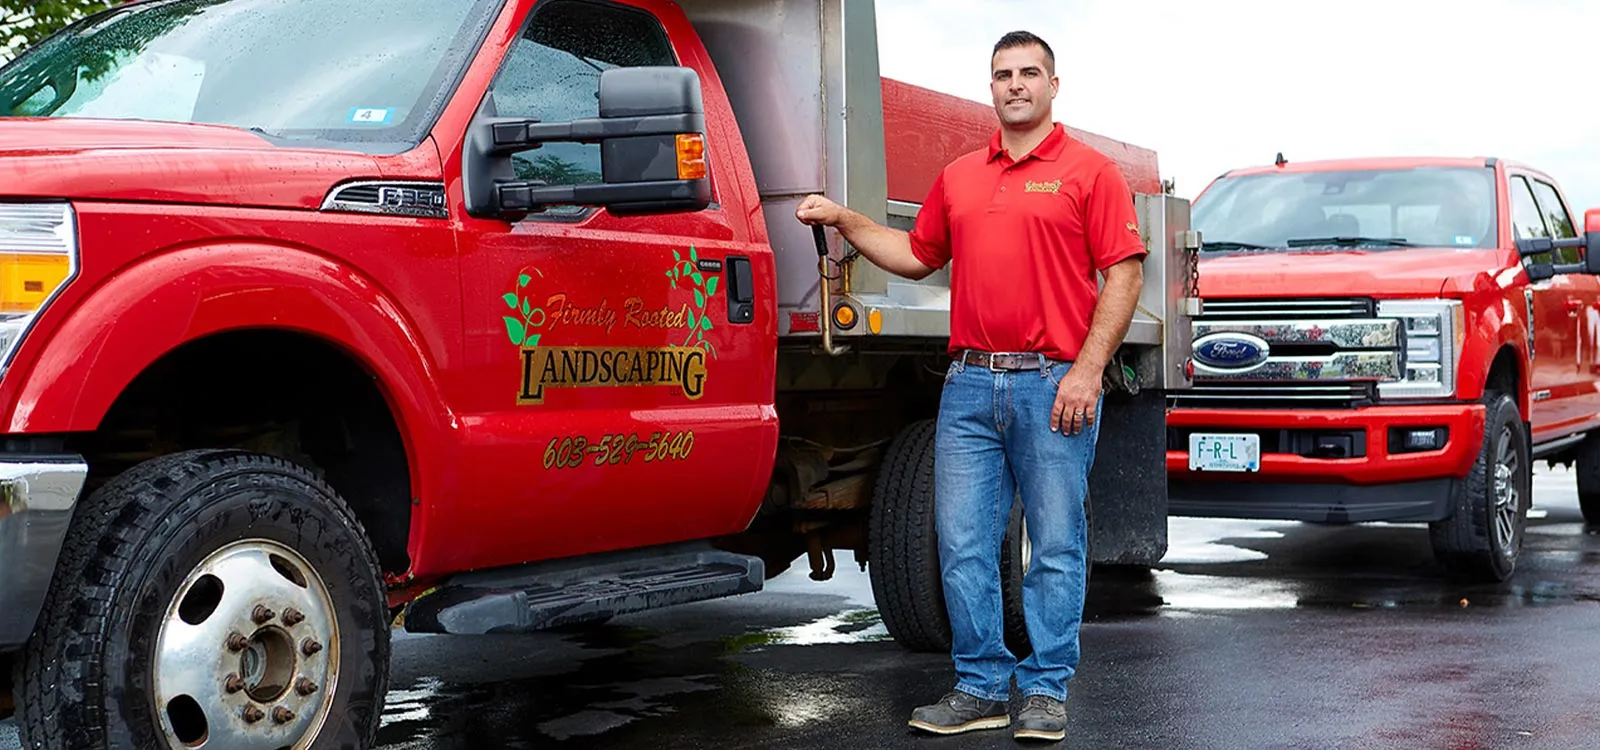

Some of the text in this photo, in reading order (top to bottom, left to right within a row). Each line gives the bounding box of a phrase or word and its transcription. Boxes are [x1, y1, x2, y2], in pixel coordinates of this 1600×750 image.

[360, 110, 372, 120] 4
[545, 291, 688, 335] Firmly Rooted
[1210, 342, 1248, 359] Ford
[519, 350, 704, 399] LANDSCAPING
[543, 430, 694, 470] 603-529-5640
[1198, 441, 1237, 459] F-R-L
